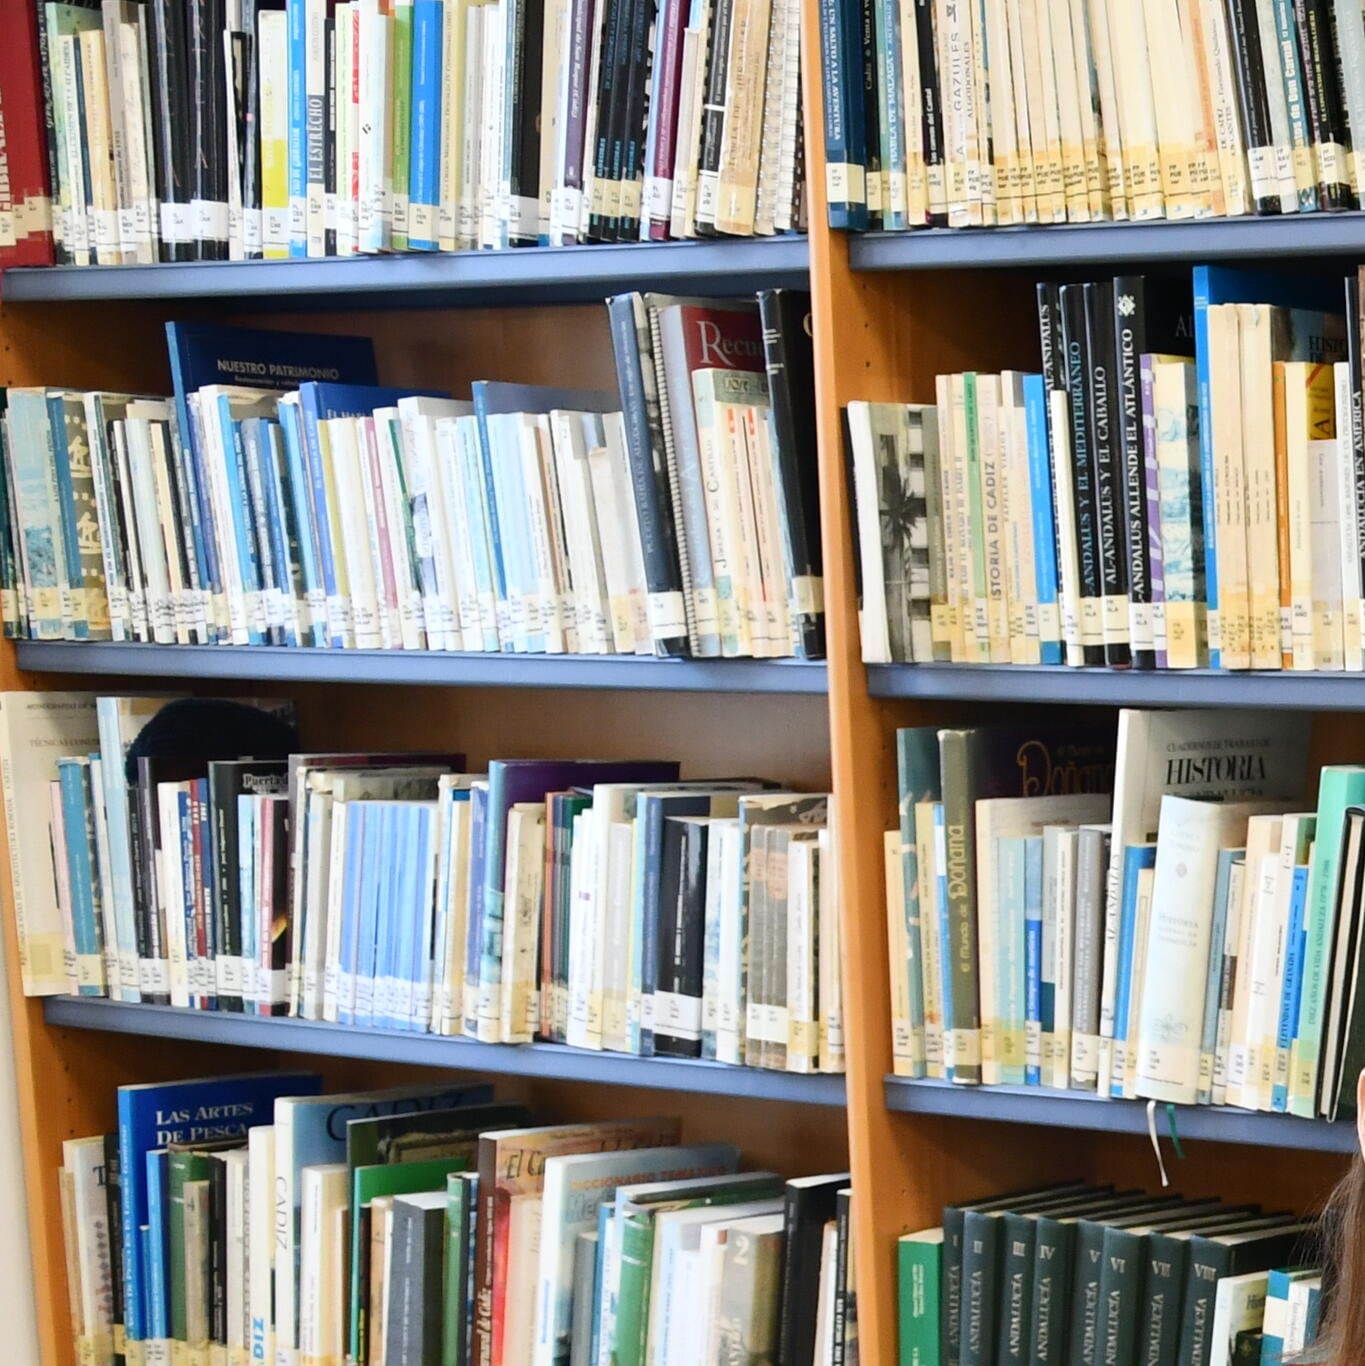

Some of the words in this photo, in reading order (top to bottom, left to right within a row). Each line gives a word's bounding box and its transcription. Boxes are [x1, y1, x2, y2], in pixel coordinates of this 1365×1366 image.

[308, 99, 323, 161] ESTRECHO
[217, 360, 266, 375] NUESTRO
[270, 364, 339, 380] PATRIMONIO
[1094, 366, 1109, 440] CABALLO
[1098, 444, 1110, 463] EL
[1100, 470, 1110, 479] Y
[1100, 486, 1117, 584] AL-ANDALUS
[1167, 755, 1266, 785] HISTORIA
[195, 1104, 254, 1121] ARTES
[157, 1131, 184, 1146] DE
[190, 1123, 249, 1141] PESCA
